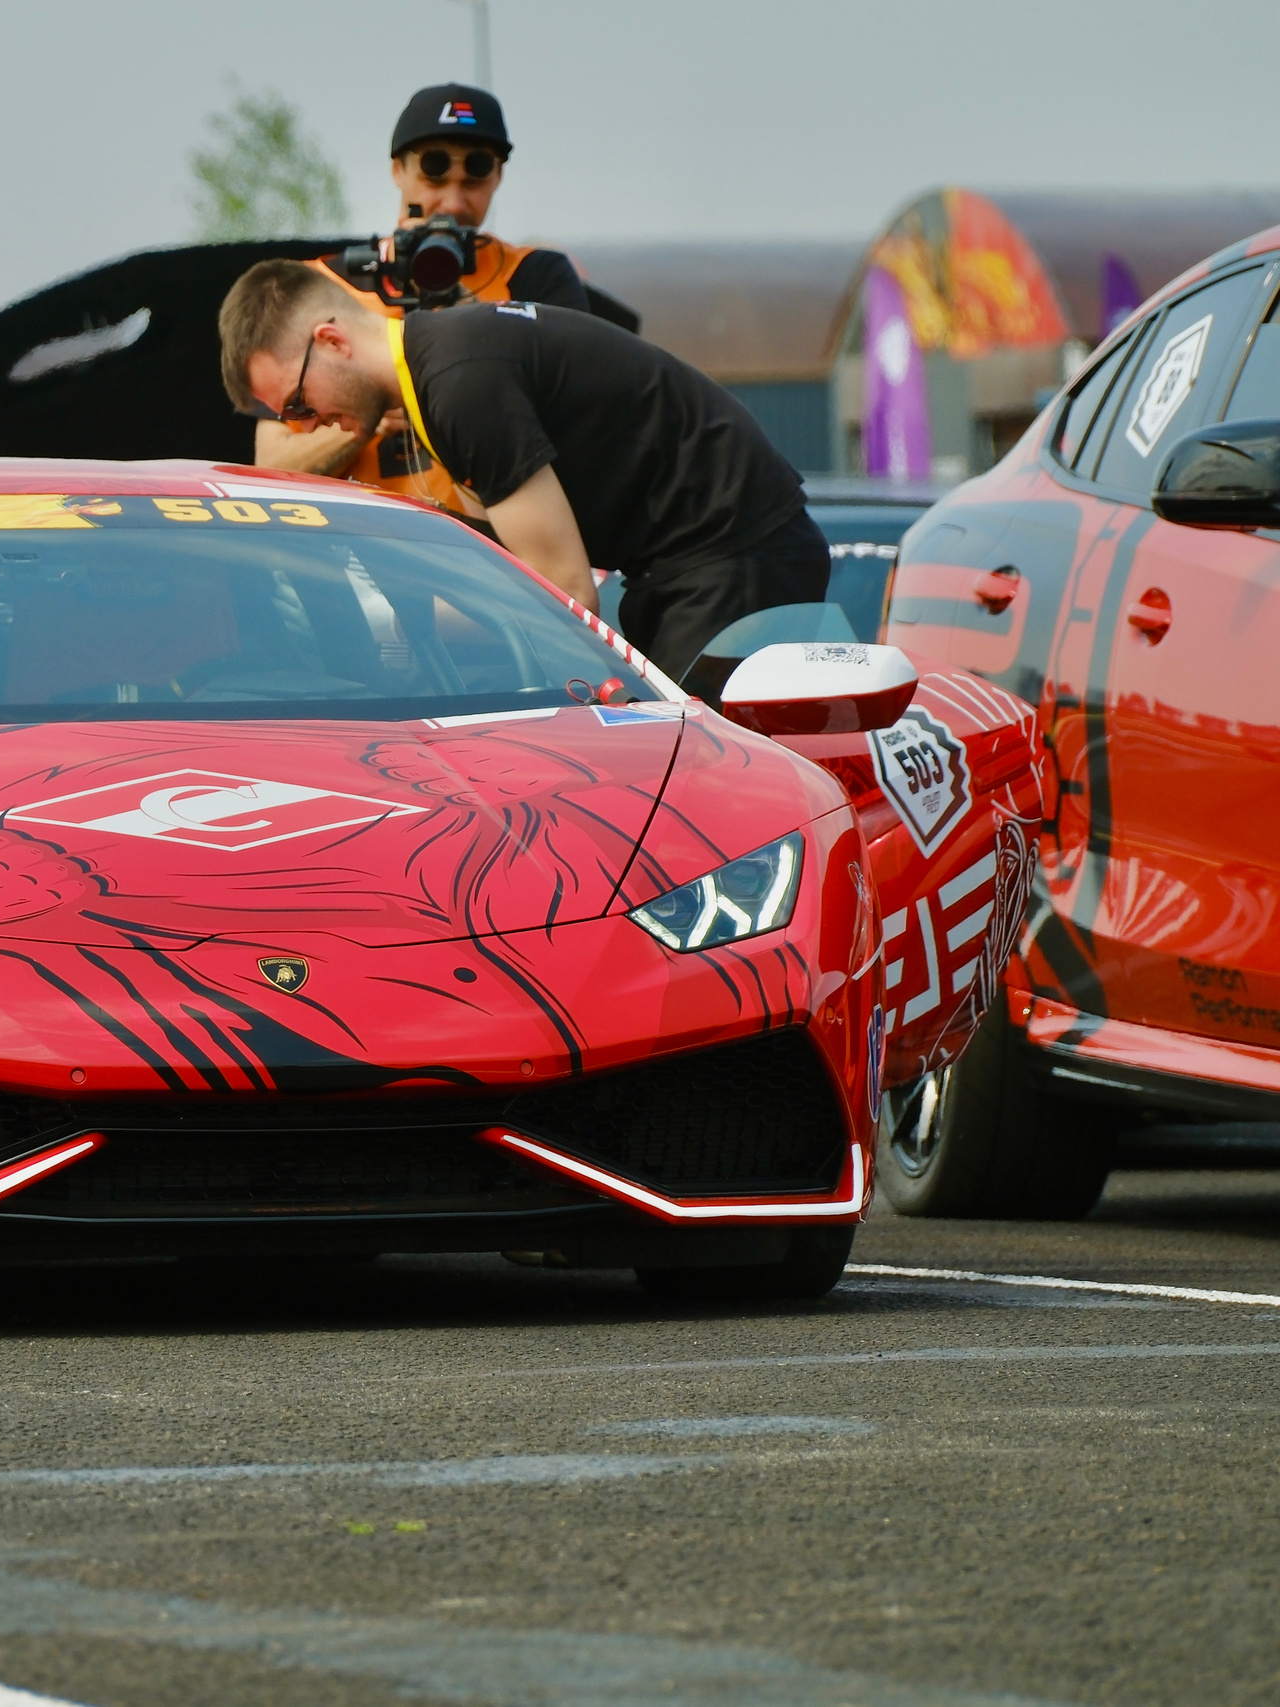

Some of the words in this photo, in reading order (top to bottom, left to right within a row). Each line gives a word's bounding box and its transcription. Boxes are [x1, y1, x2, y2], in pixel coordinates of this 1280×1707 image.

[150, 497, 331, 529] 503
[893, 740, 945, 795] 503
[261, 958, 304, 967] LAMBORGHINI
